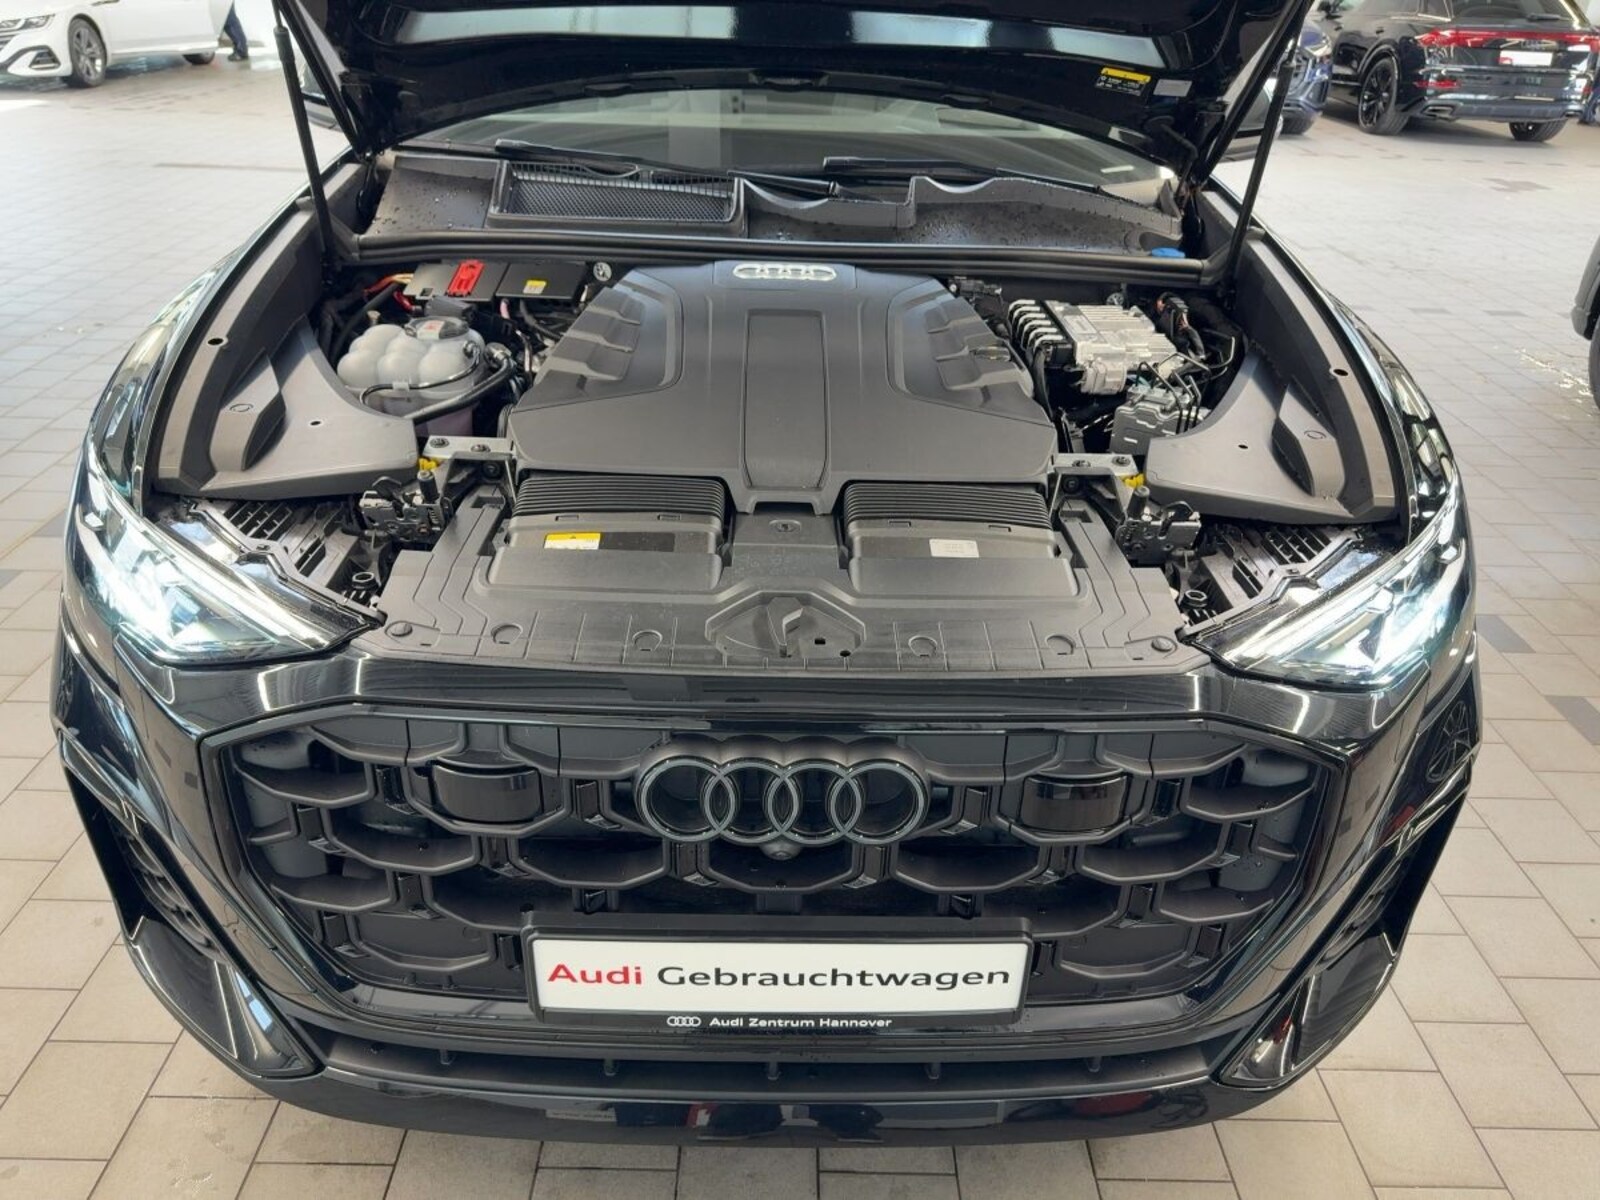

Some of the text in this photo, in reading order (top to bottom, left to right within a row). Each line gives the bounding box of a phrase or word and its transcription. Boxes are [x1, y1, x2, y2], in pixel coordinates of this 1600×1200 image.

[547, 963, 1010, 991] Audi Gebrauchtwagen
[709, 1016, 893, 1028] Audi Zentrum Hannover
